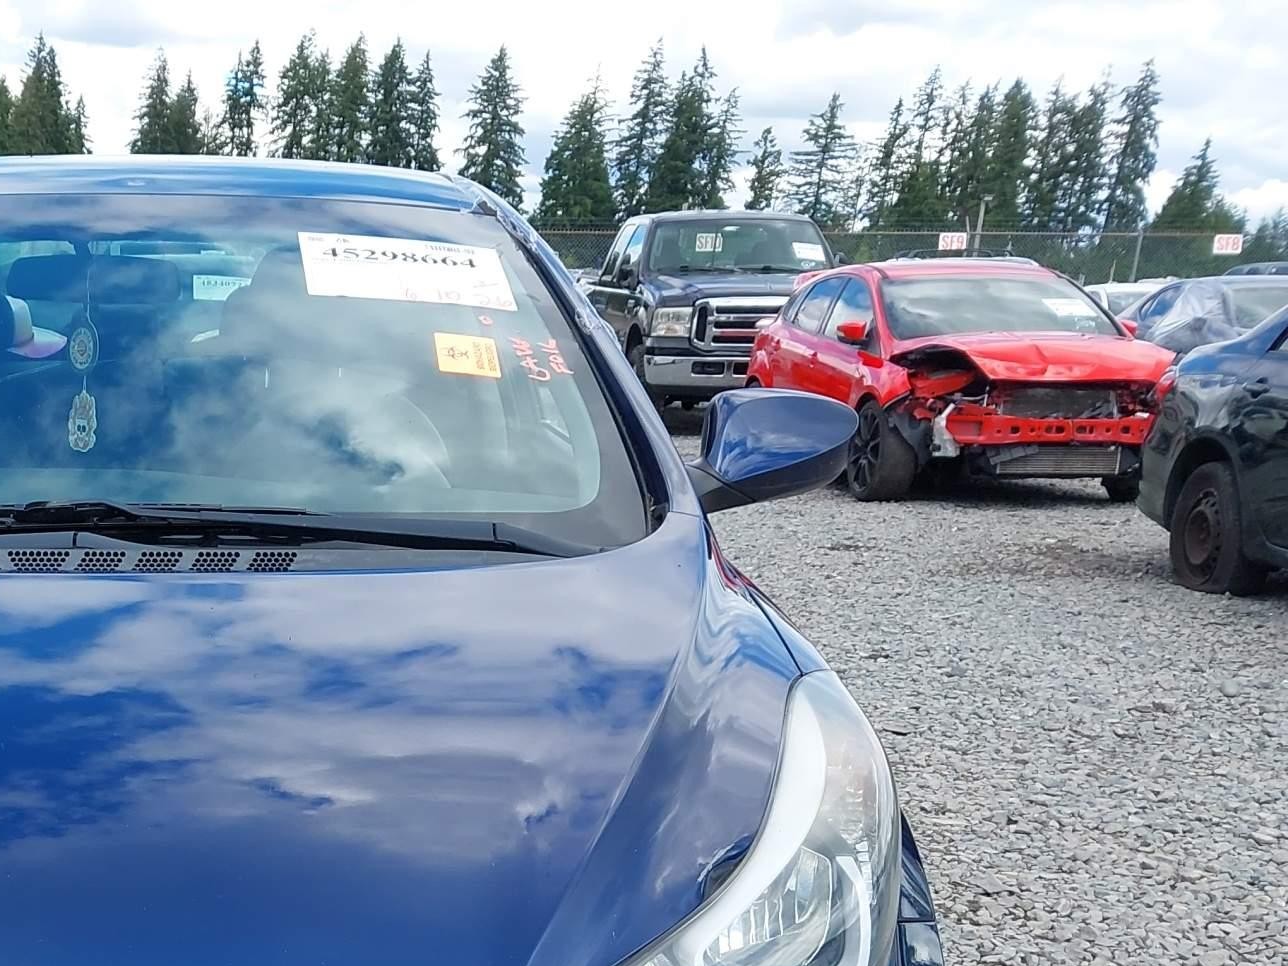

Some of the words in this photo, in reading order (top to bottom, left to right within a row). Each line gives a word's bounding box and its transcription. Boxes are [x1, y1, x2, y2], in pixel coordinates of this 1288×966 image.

[942, 235, 964, 249] SF9
[1217, 236, 1240, 251] SF8
[322, 246, 476, 268] 45298664
